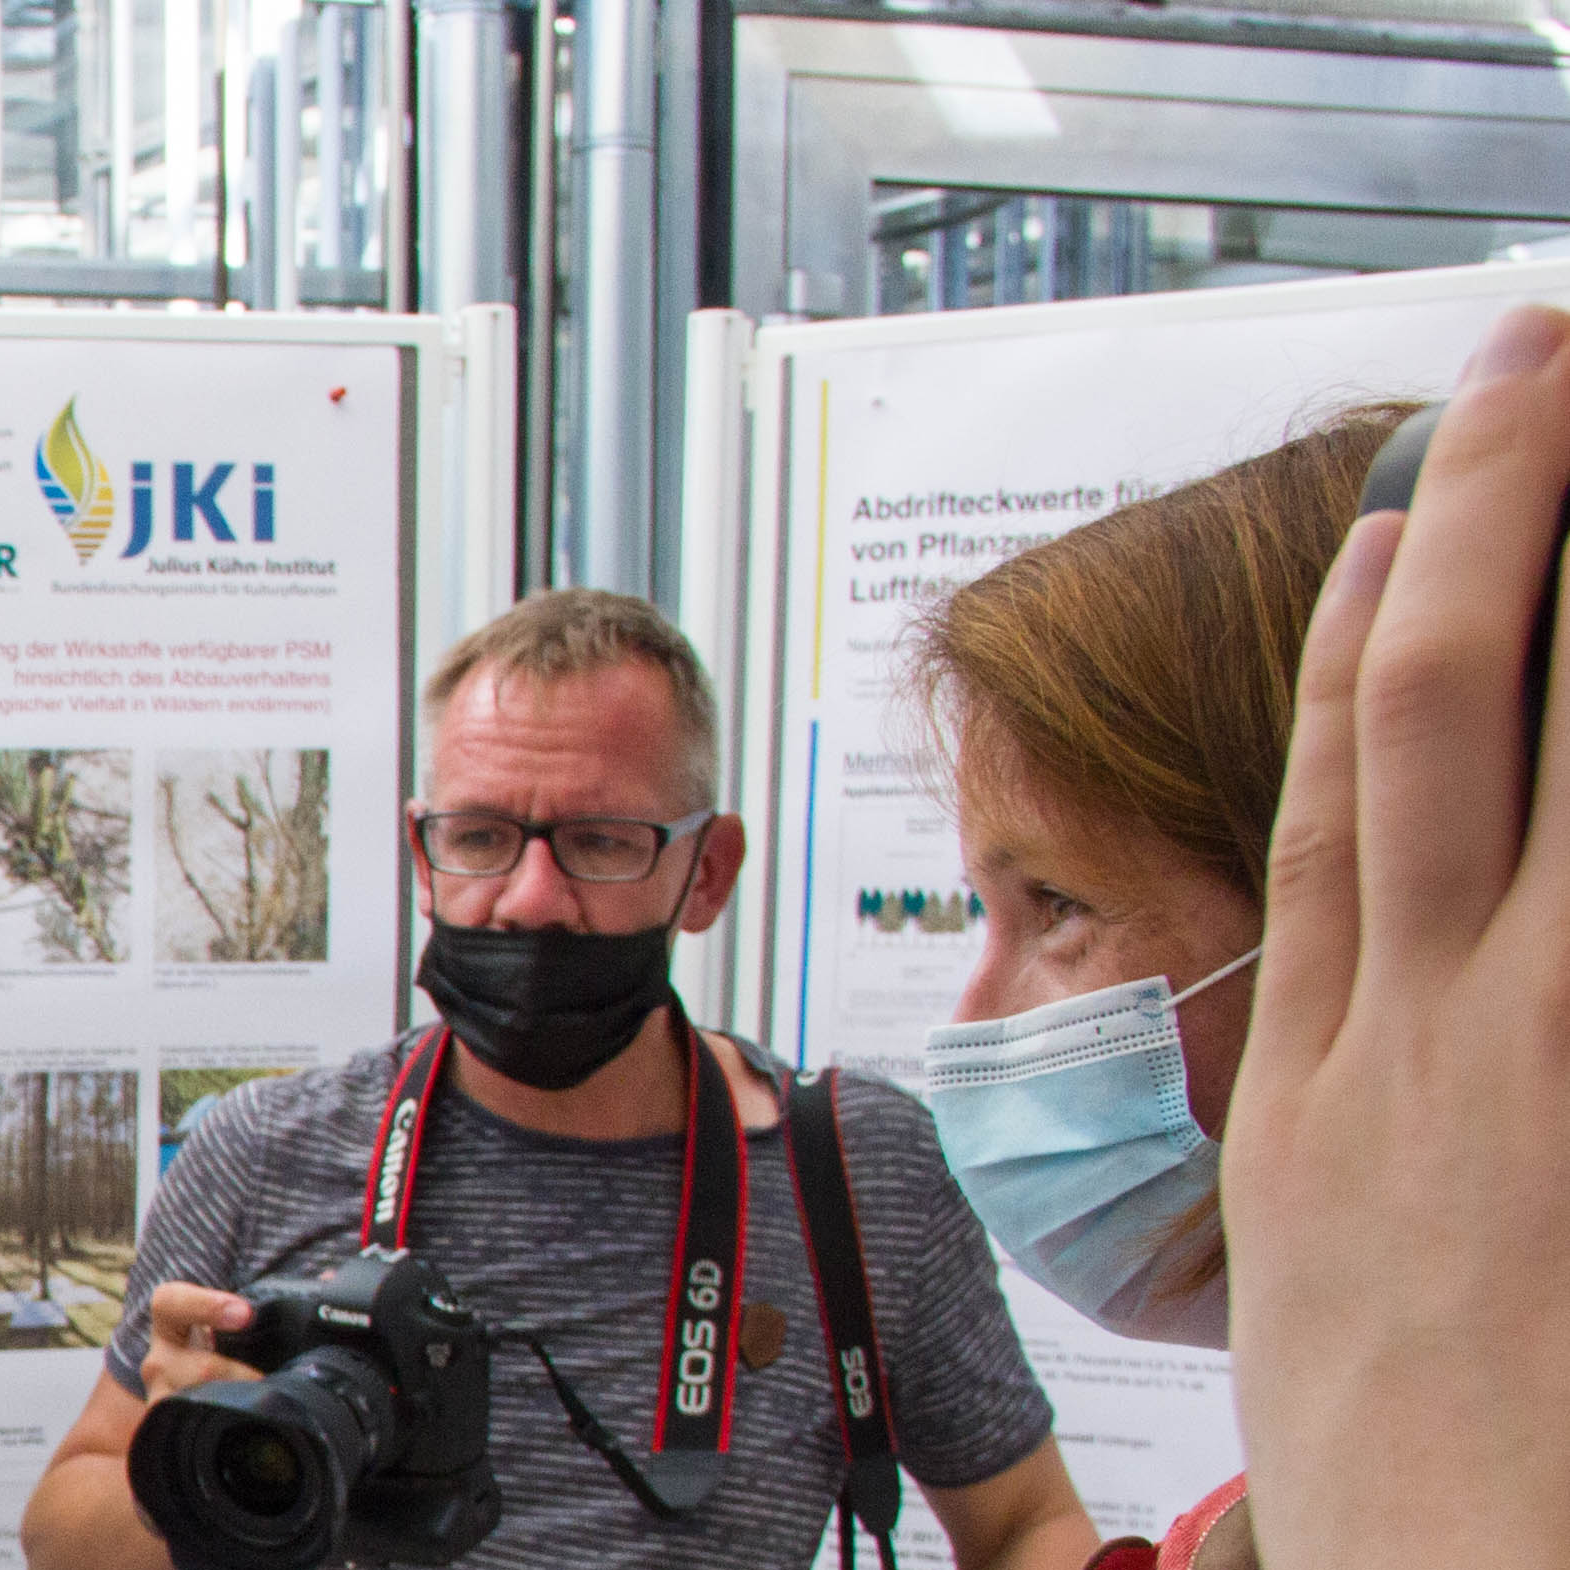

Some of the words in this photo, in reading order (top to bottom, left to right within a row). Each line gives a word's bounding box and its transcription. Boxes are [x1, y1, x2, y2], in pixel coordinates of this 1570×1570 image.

[853, 488, 1106, 521] Abdrifteckwerte
[852, 543, 907, 560] von
[147, 557, 201, 574] Julius
[207, 558, 335, 575] Kühn-Institut
[26, 641, 57, 658] der
[64, 641, 162, 658] Wirkstoffe
[168, 641, 279, 663] verfügbarer
[285, 640, 331, 659] PSM
[14, 669, 123, 687] hinsichtlich
[129, 670, 164, 687] des
[171, 670, 331, 687] Abbauverhaltens
[69, 696, 126, 711] Vielfalt
[131, 699, 146, 711] in
[374, 1099, 416, 1223] Canon
[687, 1260, 724, 1311] 6D
[318, 1305, 371, 1327] Canon
[677, 1319, 716, 1415] EOS
[840, 1347, 872, 1418] EOS
